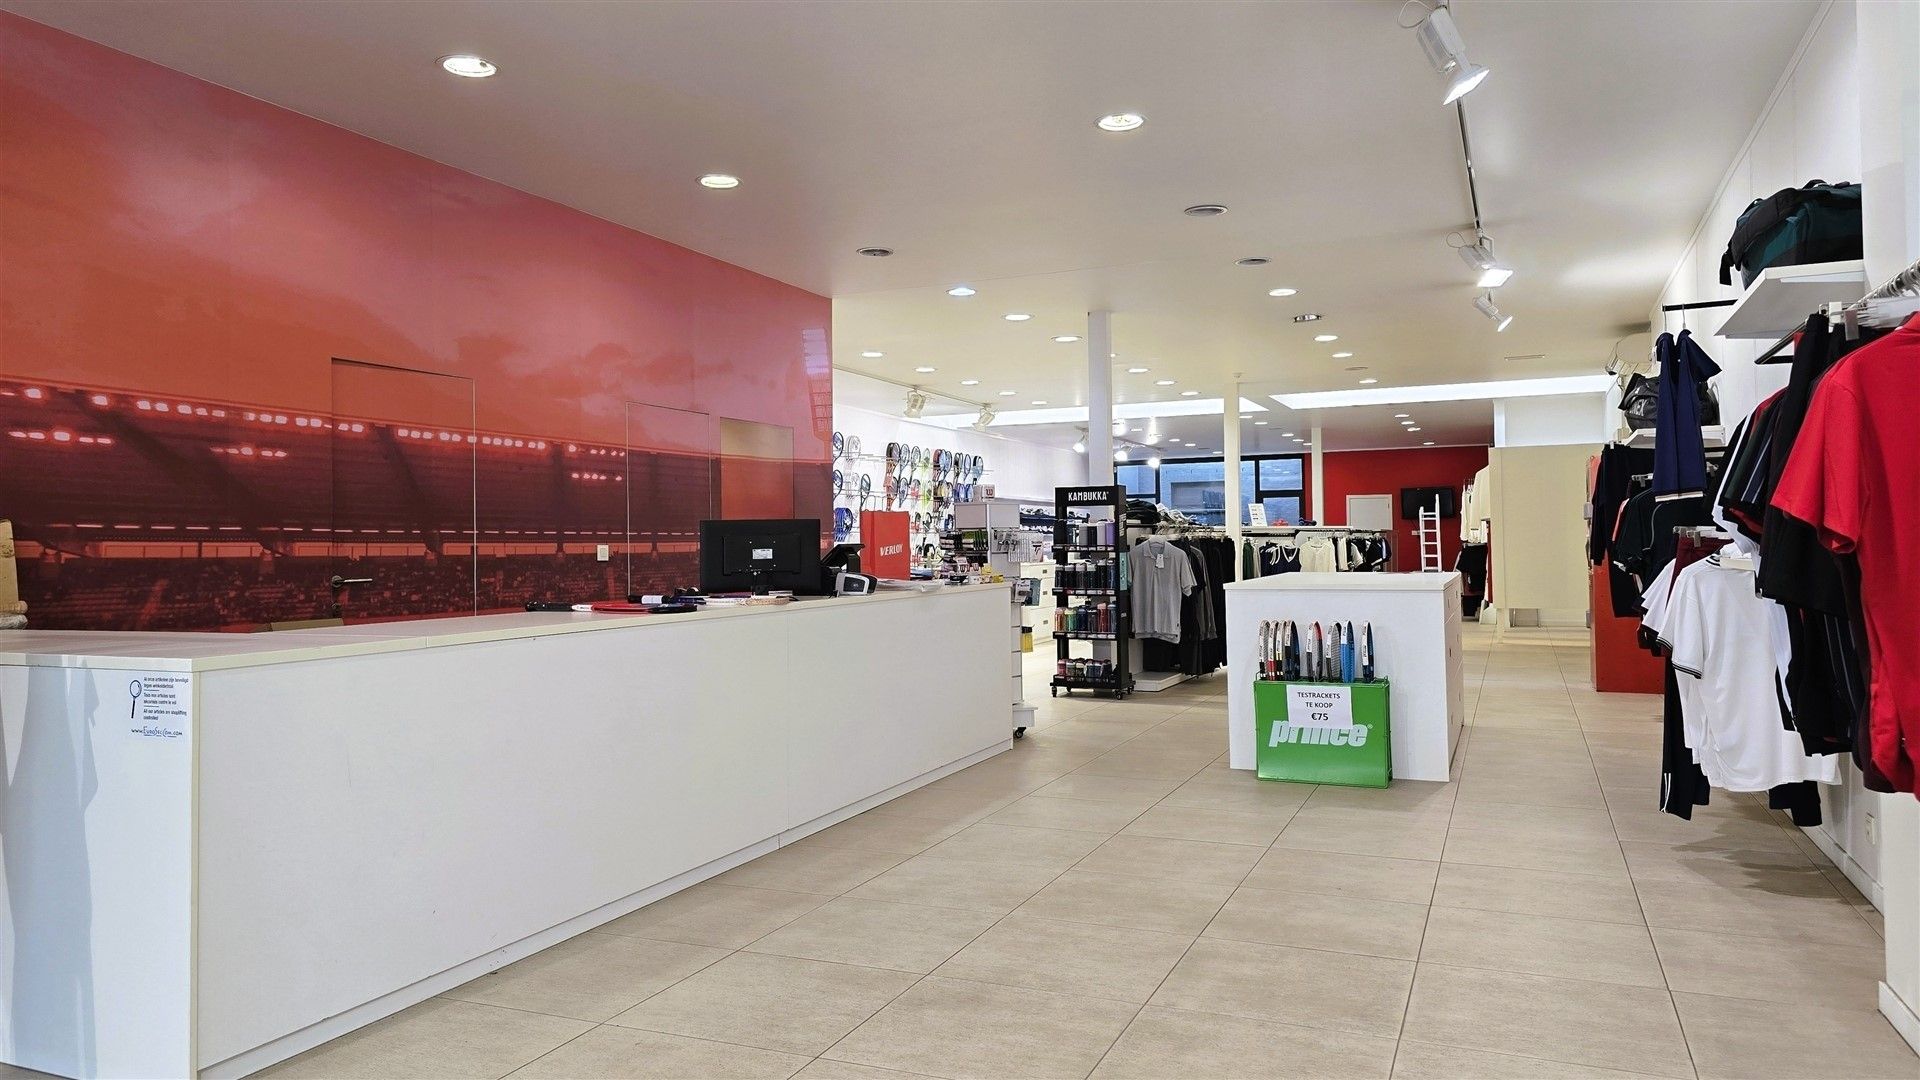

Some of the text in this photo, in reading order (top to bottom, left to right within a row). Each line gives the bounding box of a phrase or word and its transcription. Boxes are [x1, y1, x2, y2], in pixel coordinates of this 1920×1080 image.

[1068, 491, 1107, 501] KAMBUKKA
[1297, 691, 1340, 699] TESTRACKETS
[1311, 713, 1329, 721] €75
